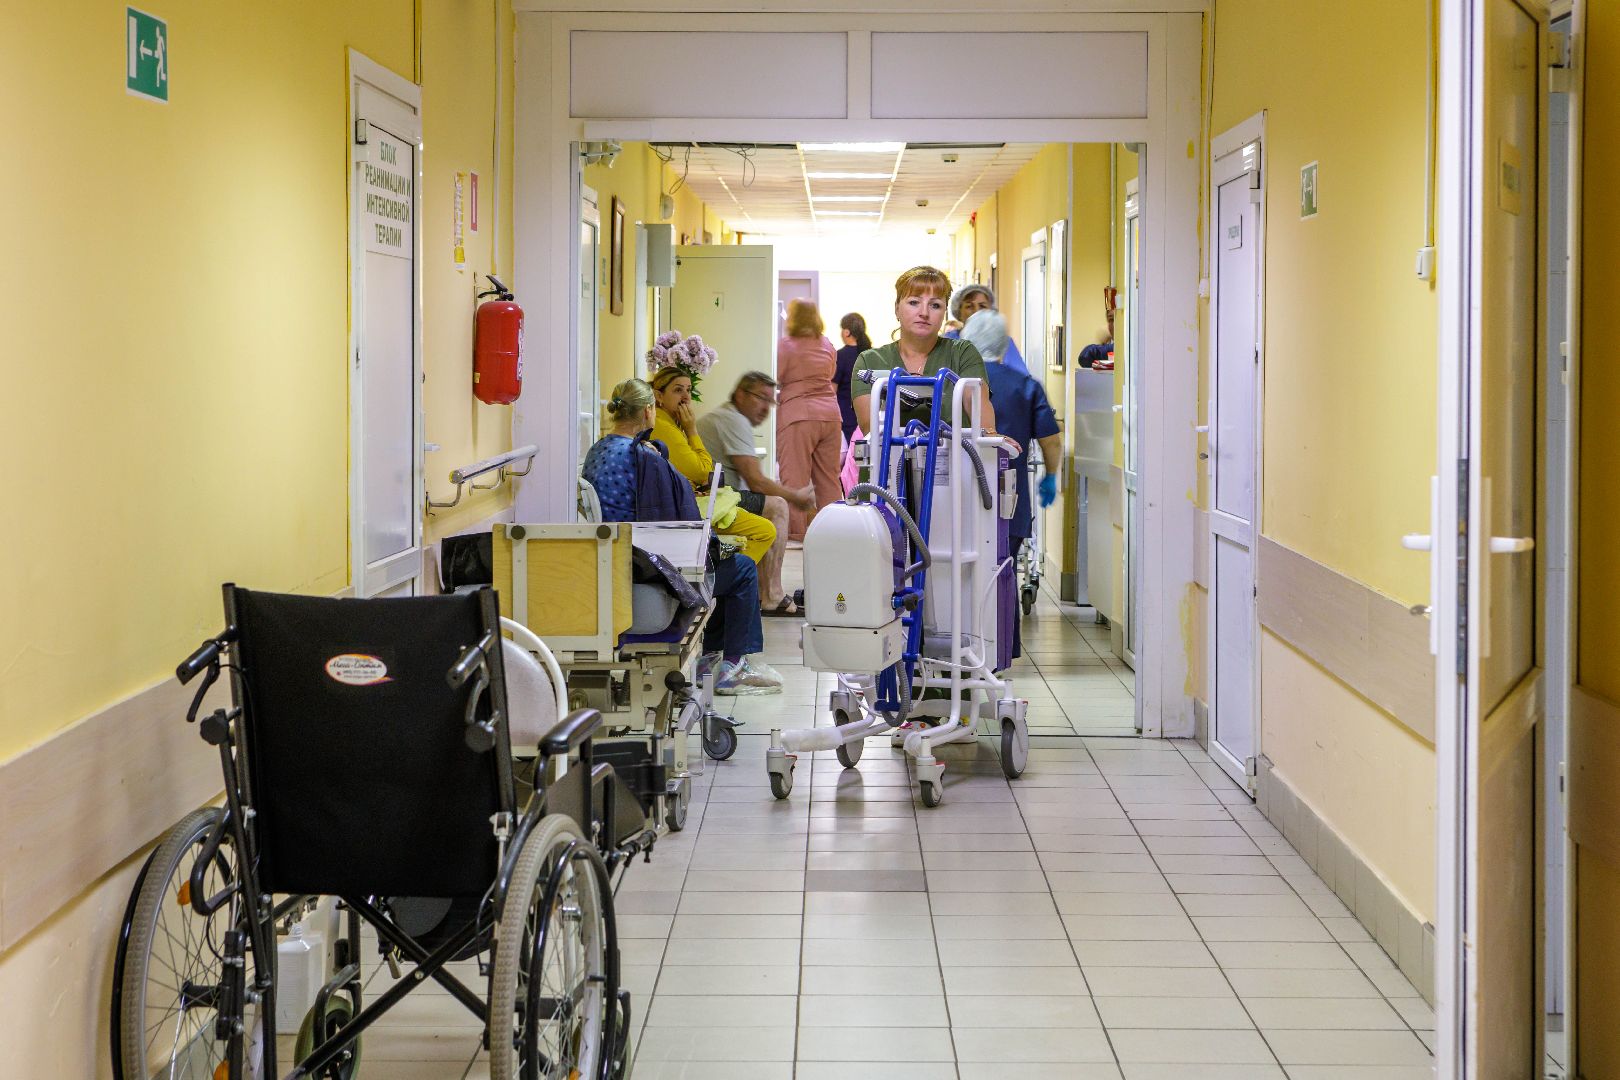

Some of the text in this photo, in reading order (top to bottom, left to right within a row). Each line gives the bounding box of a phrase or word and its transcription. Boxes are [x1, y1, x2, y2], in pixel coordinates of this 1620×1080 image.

[381, 142, 396, 166] БЛОК
[365, 163, 411, 198] РЕАНИМАЦИИ И
[366, 192, 410, 224] ИНТЕНСИВНОЙ
[375, 223, 402, 248] ТЕРАПИИ
